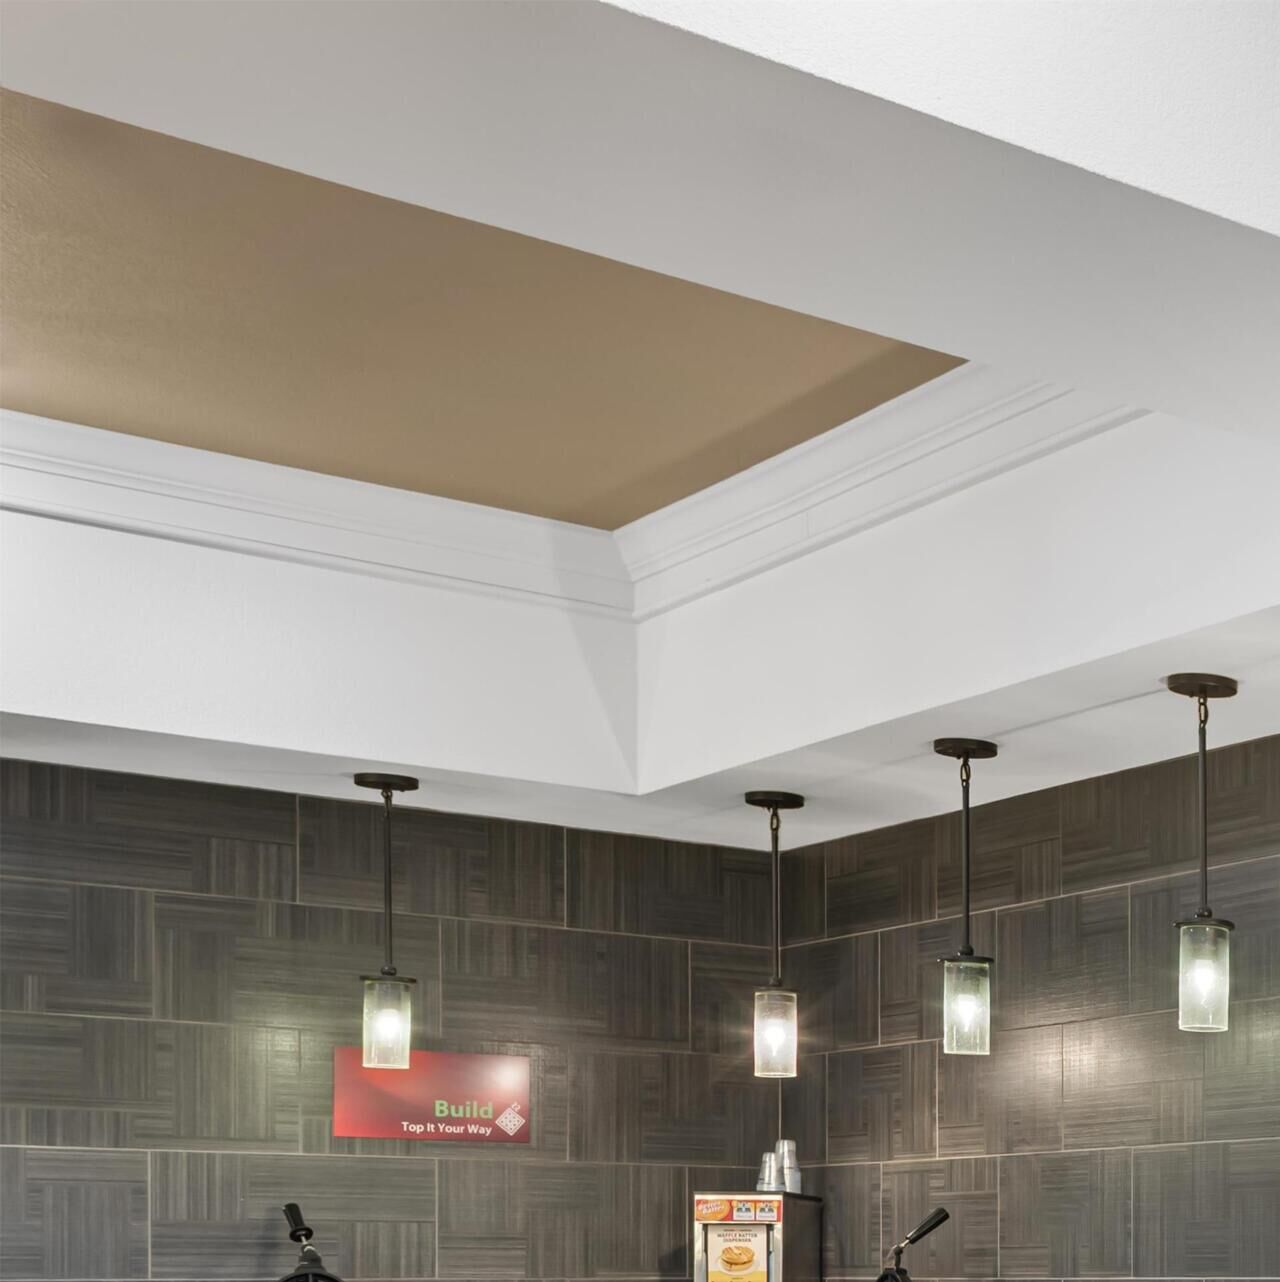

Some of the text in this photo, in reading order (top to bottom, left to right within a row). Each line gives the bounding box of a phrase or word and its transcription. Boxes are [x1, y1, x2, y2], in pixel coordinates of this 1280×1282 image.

[434, 1100, 493, 1119] Build
[401, 1121, 492, 1136] Top It Your Way
